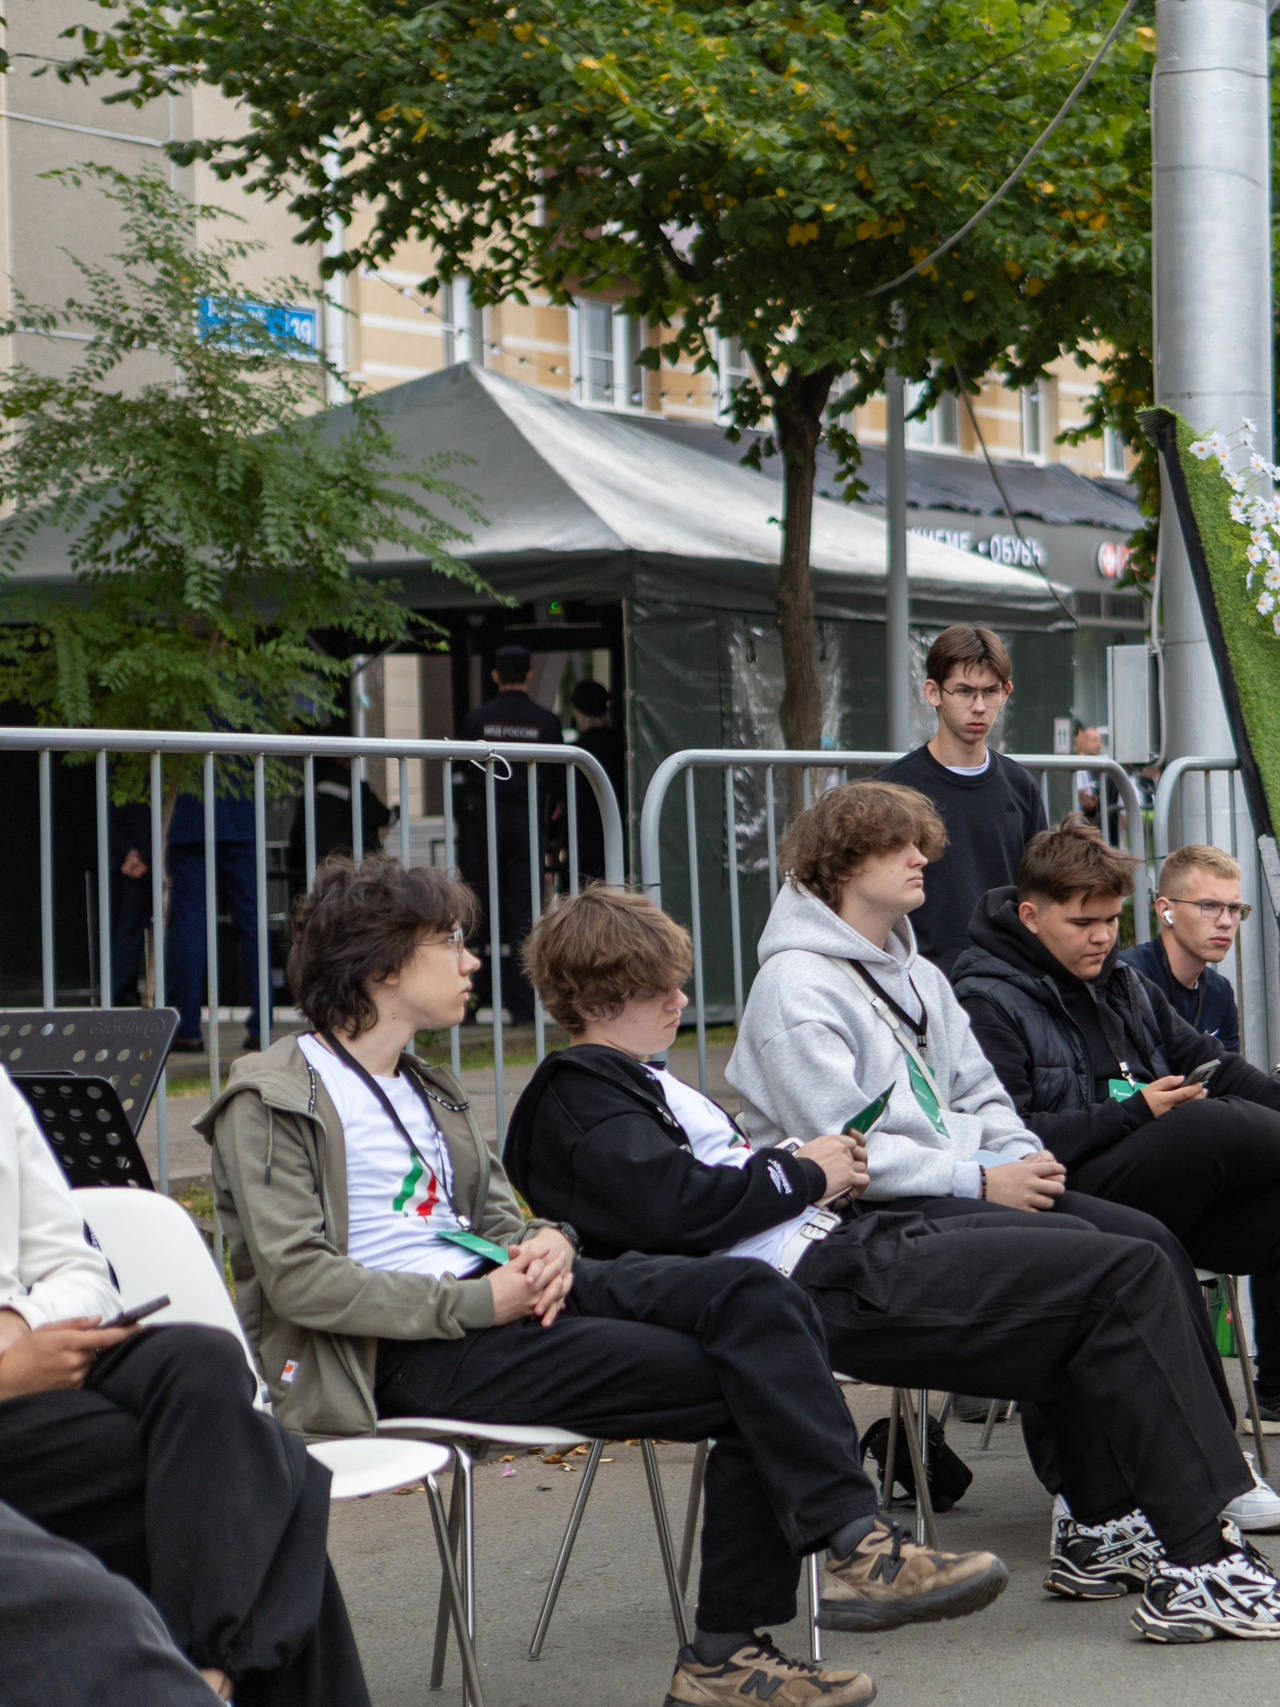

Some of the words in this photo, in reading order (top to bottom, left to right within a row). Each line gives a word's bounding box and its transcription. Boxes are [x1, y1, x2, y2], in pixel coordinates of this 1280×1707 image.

[990, 533, 1045, 567] ОБУВЬ
[503, 725, 539, 739] РОССИИ
[89, 1021, 144, 1036] Gravity
